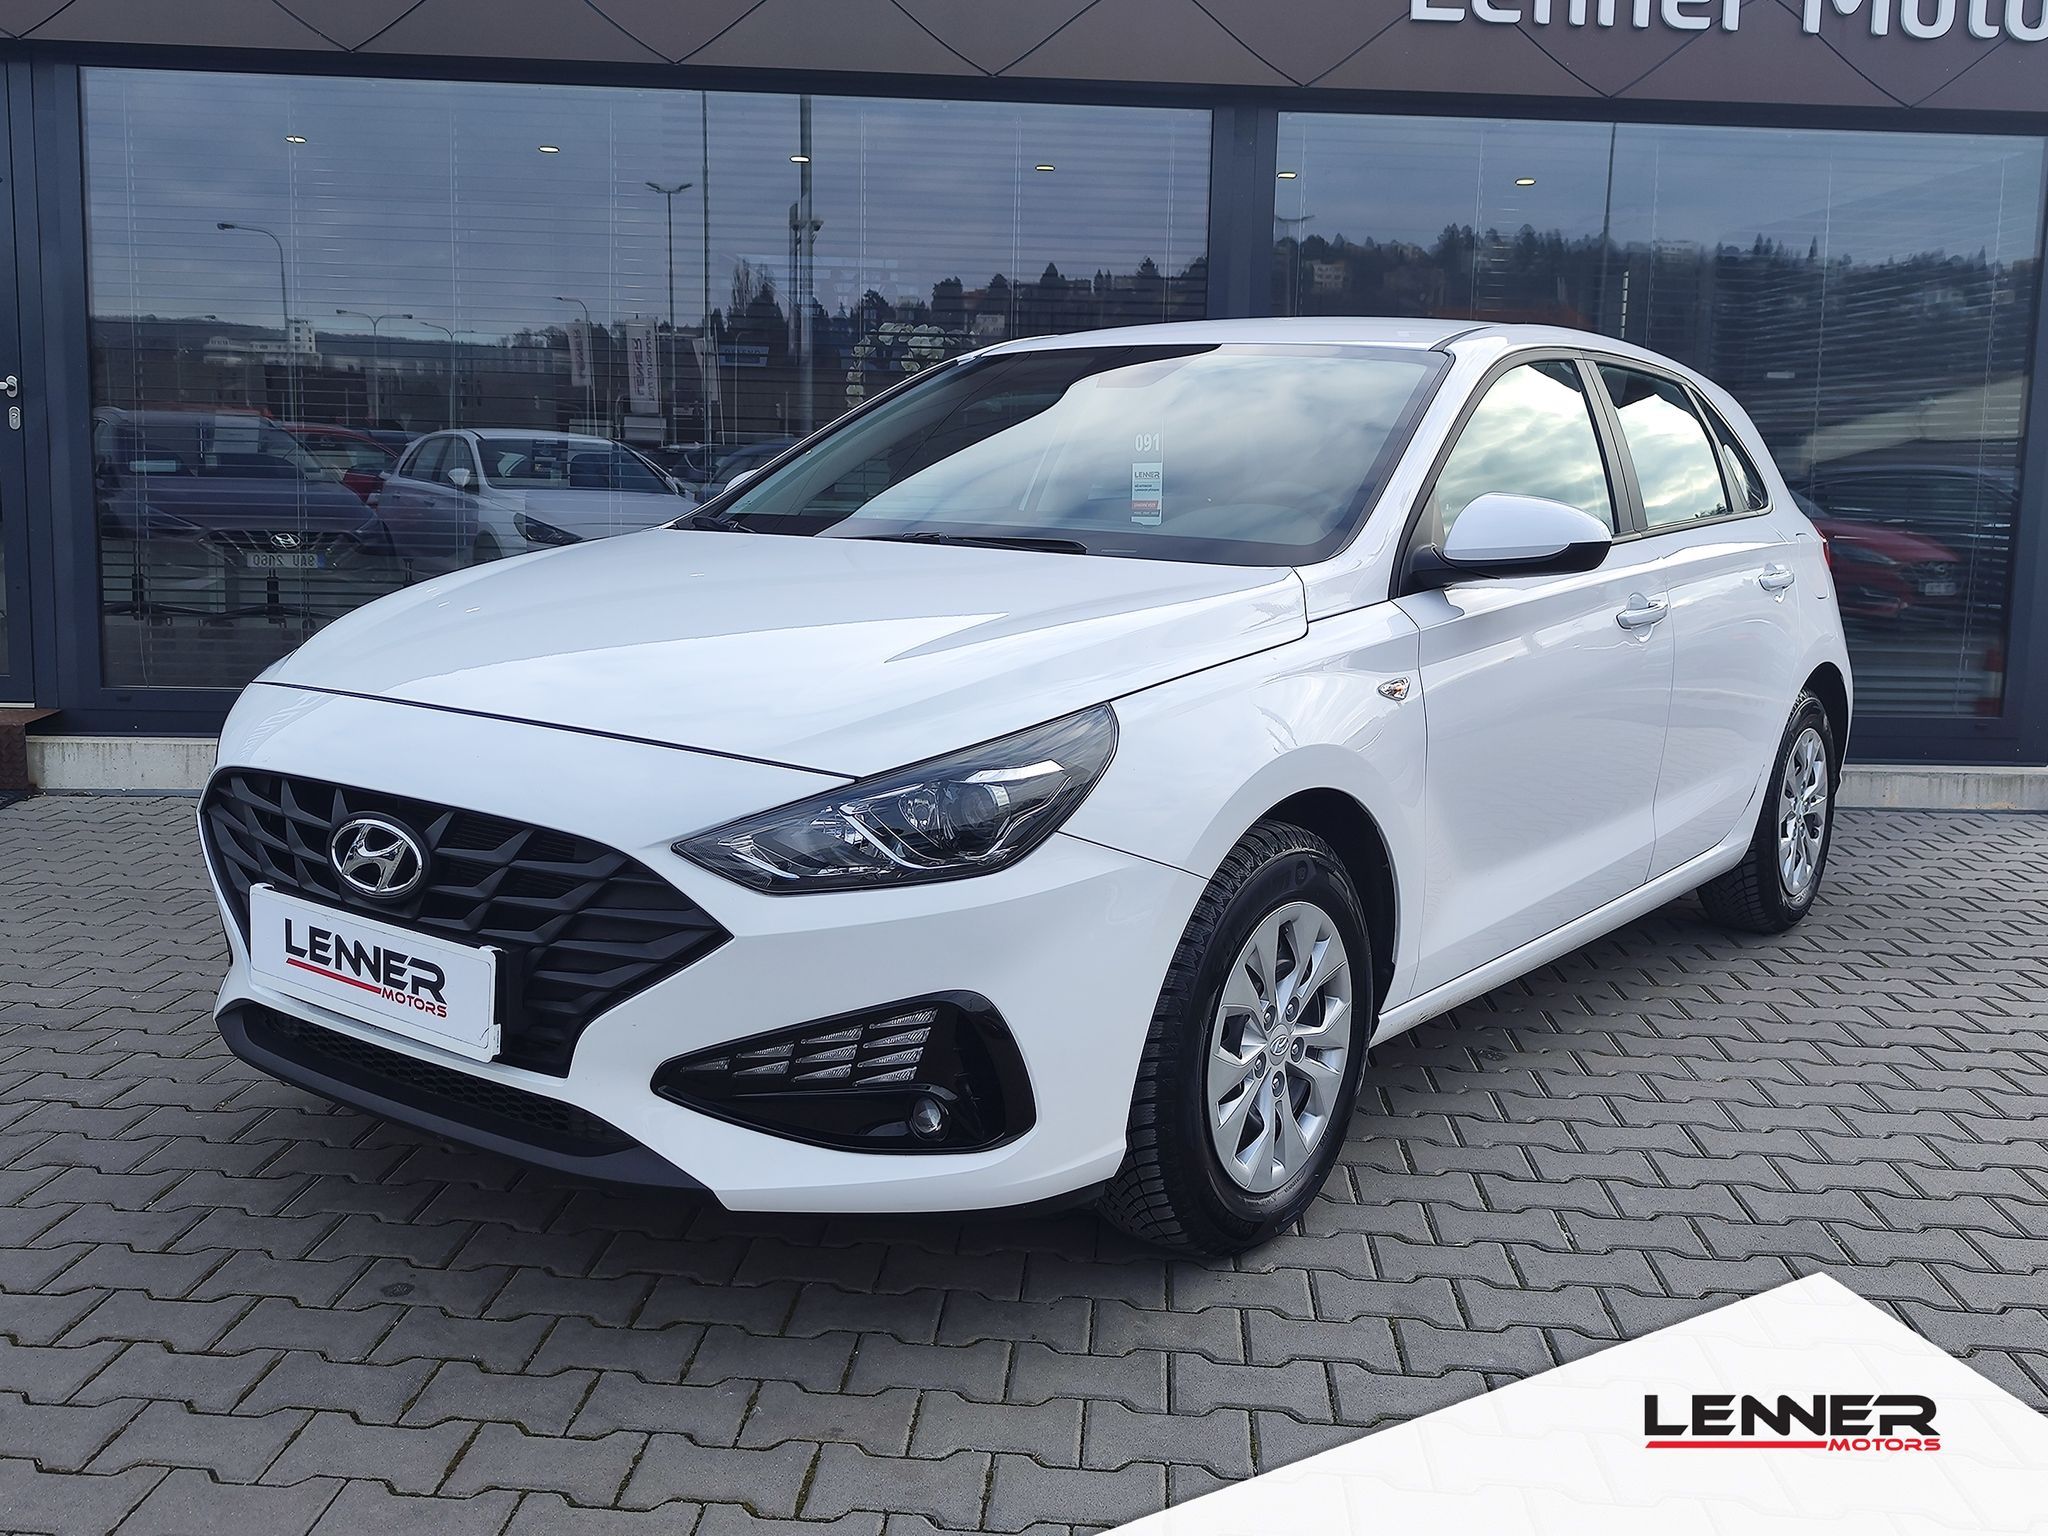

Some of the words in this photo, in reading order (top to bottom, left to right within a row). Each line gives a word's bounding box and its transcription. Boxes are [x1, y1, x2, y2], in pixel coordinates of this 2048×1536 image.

[1135, 433, 1160, 453] 091
[1134, 471, 1160, 479] LENNER
[284, 917, 447, 1005] LENNER
[381, 987, 448, 1019] MOTORS
